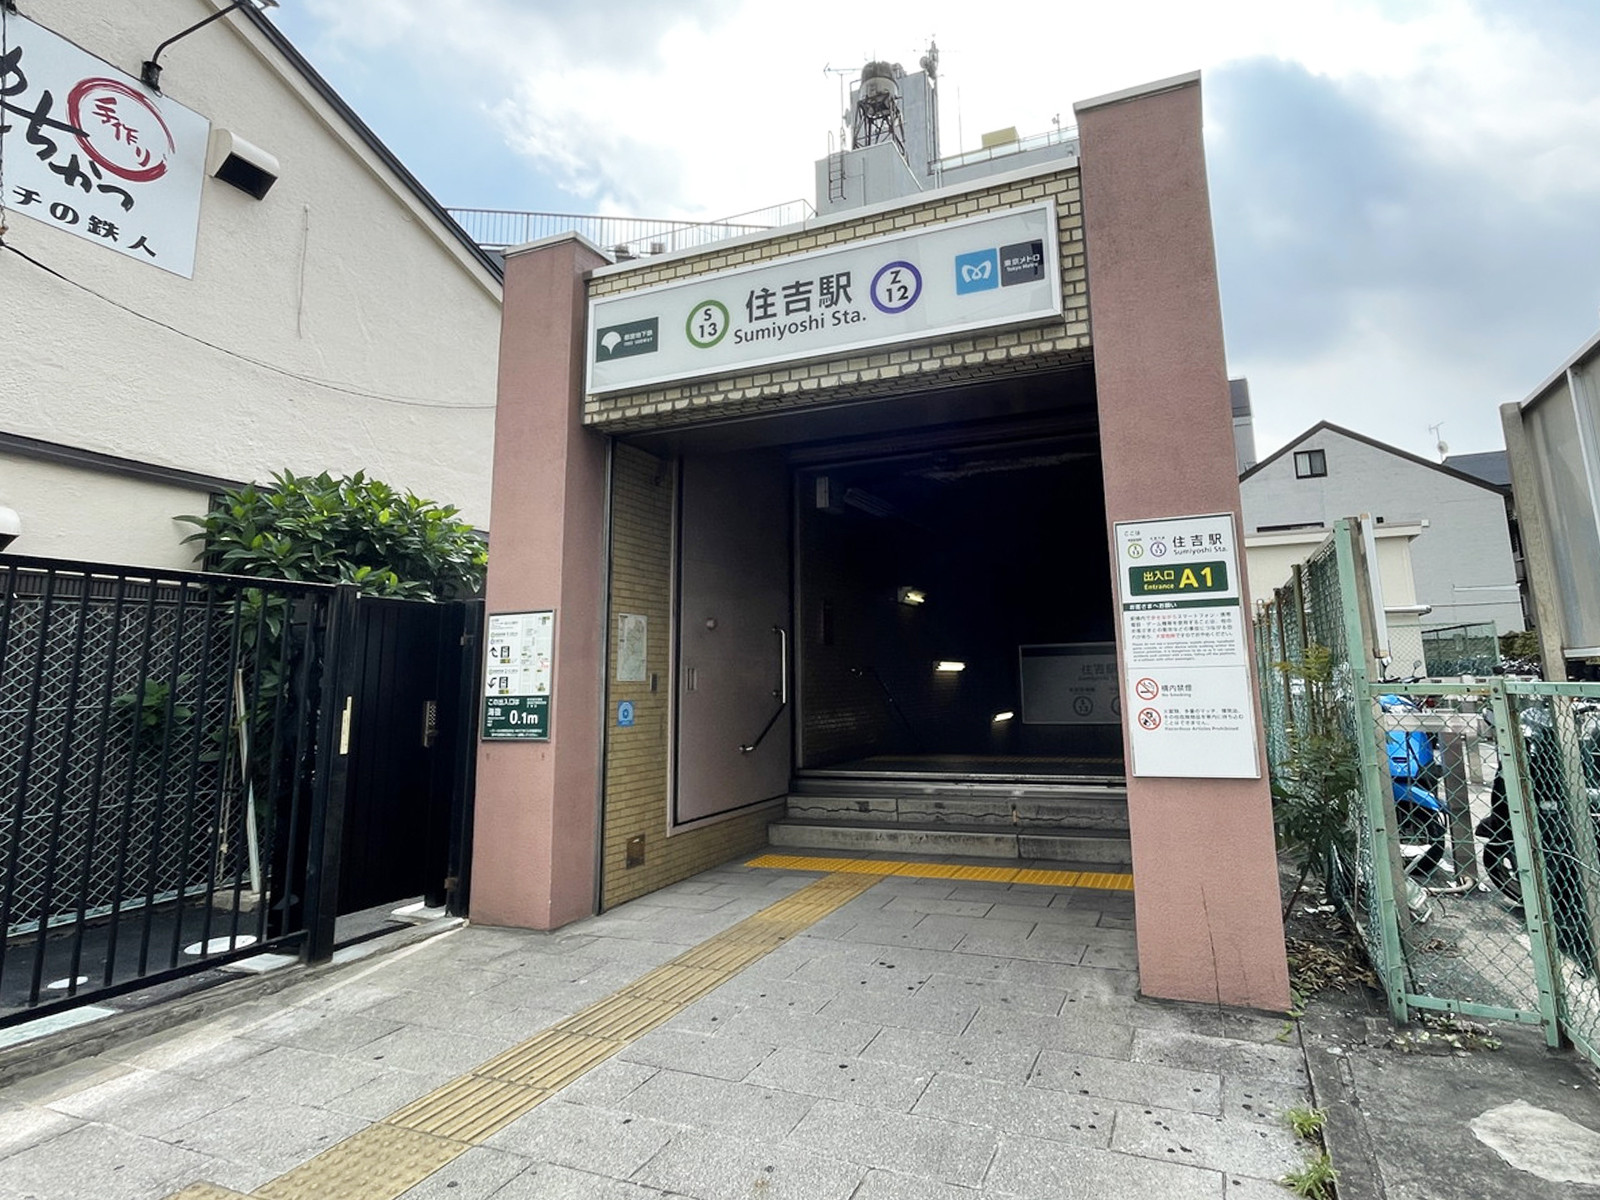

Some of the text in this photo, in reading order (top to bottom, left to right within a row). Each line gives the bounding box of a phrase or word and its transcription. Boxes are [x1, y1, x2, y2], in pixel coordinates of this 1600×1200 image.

[92, 96, 151, 168] 手作り
[12, 185, 157, 258] チの鉄人
[890, 269, 902, 285] Z
[746, 271, 853, 324] 住吉駅
[886, 285, 909, 303] 12
[703, 308, 713, 322] S
[698, 322, 718, 338] 13
[733, 310, 867, 345] Sumiyoshi Sta.
[1172, 533, 1222, 548] 住吉駅
[1173, 547, 1212, 556] Sumiyoshi
[1143, 570, 1175, 583] 出入口
[1178, 566, 1213, 588] A1
[1143, 583, 1175, 591] Entrance
[509, 709, 538, 725] 0.1m
